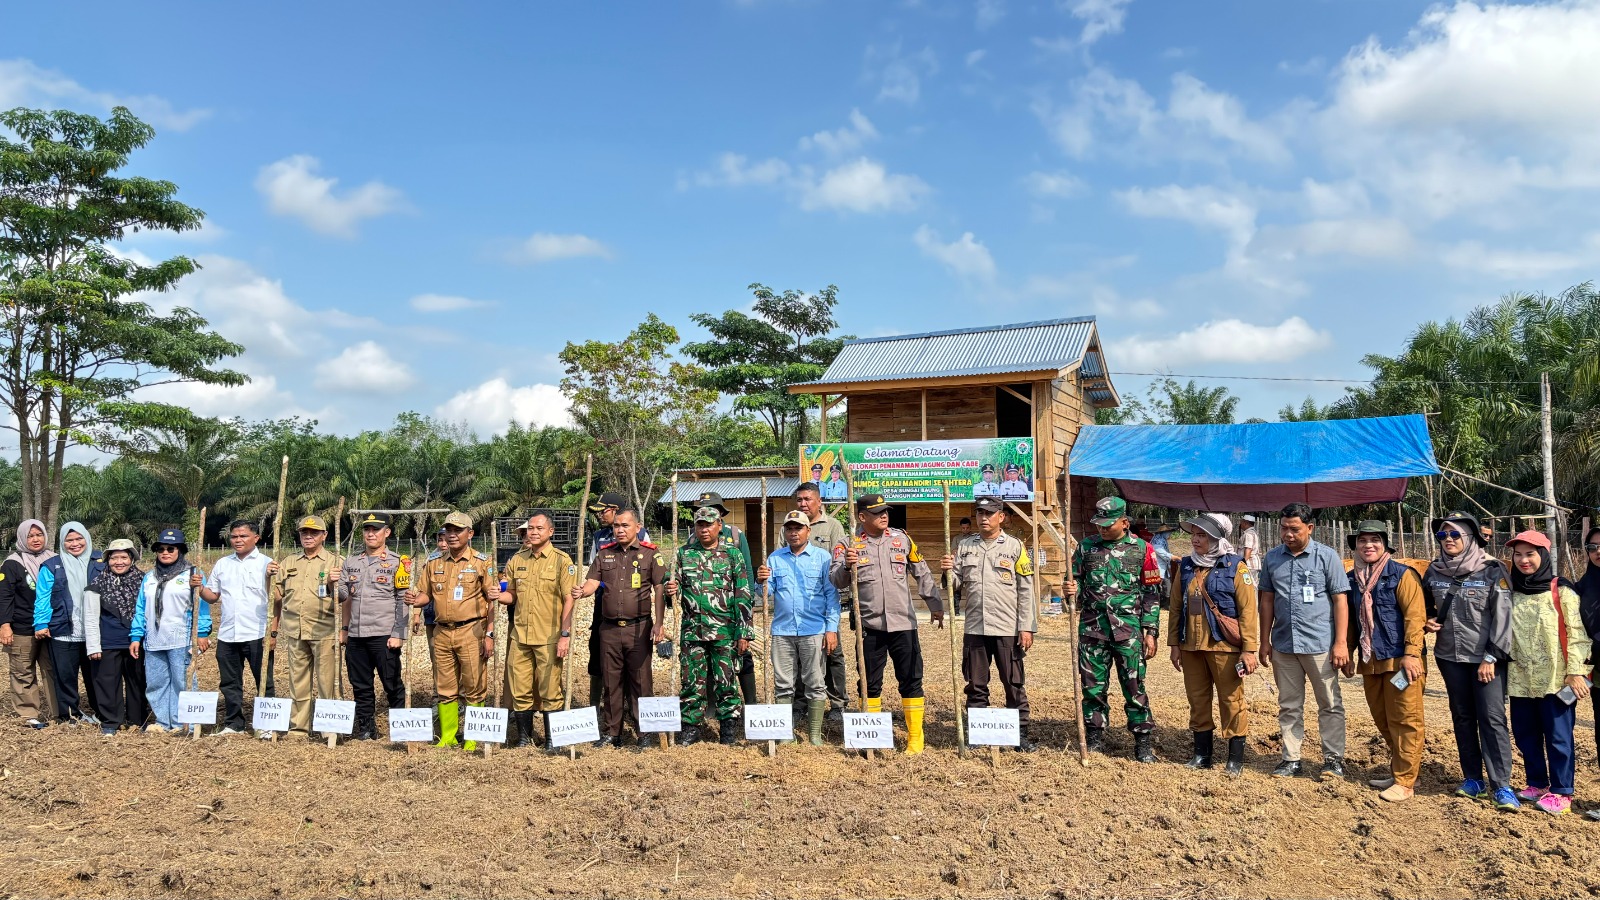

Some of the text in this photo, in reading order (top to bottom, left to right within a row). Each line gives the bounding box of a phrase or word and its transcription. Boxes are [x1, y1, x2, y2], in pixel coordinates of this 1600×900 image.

[865, 447, 912, 459] Selamat
[853, 480, 880, 488] BUMDES
[902, 479, 932, 487] MANDIRI
[187, 704, 205, 713] BPD
[259, 701, 282, 710] DINAS
[260, 711, 279, 720] TPHP
[315, 711, 351, 721] KAPOLSEK
[469, 709, 502, 721] WAKIL
[640, 710, 678, 719] DANRAMIL
[391, 719, 429, 729] CAMAT
[749, 718, 786, 728] KADES
[851, 717, 882, 726] DINAS
[970, 721, 1015, 730] KAPOLRES
[467, 722, 501, 733] BUPATI
[551, 720, 594, 733] KEJAKSAAN
[856, 730, 879, 739] PMD
